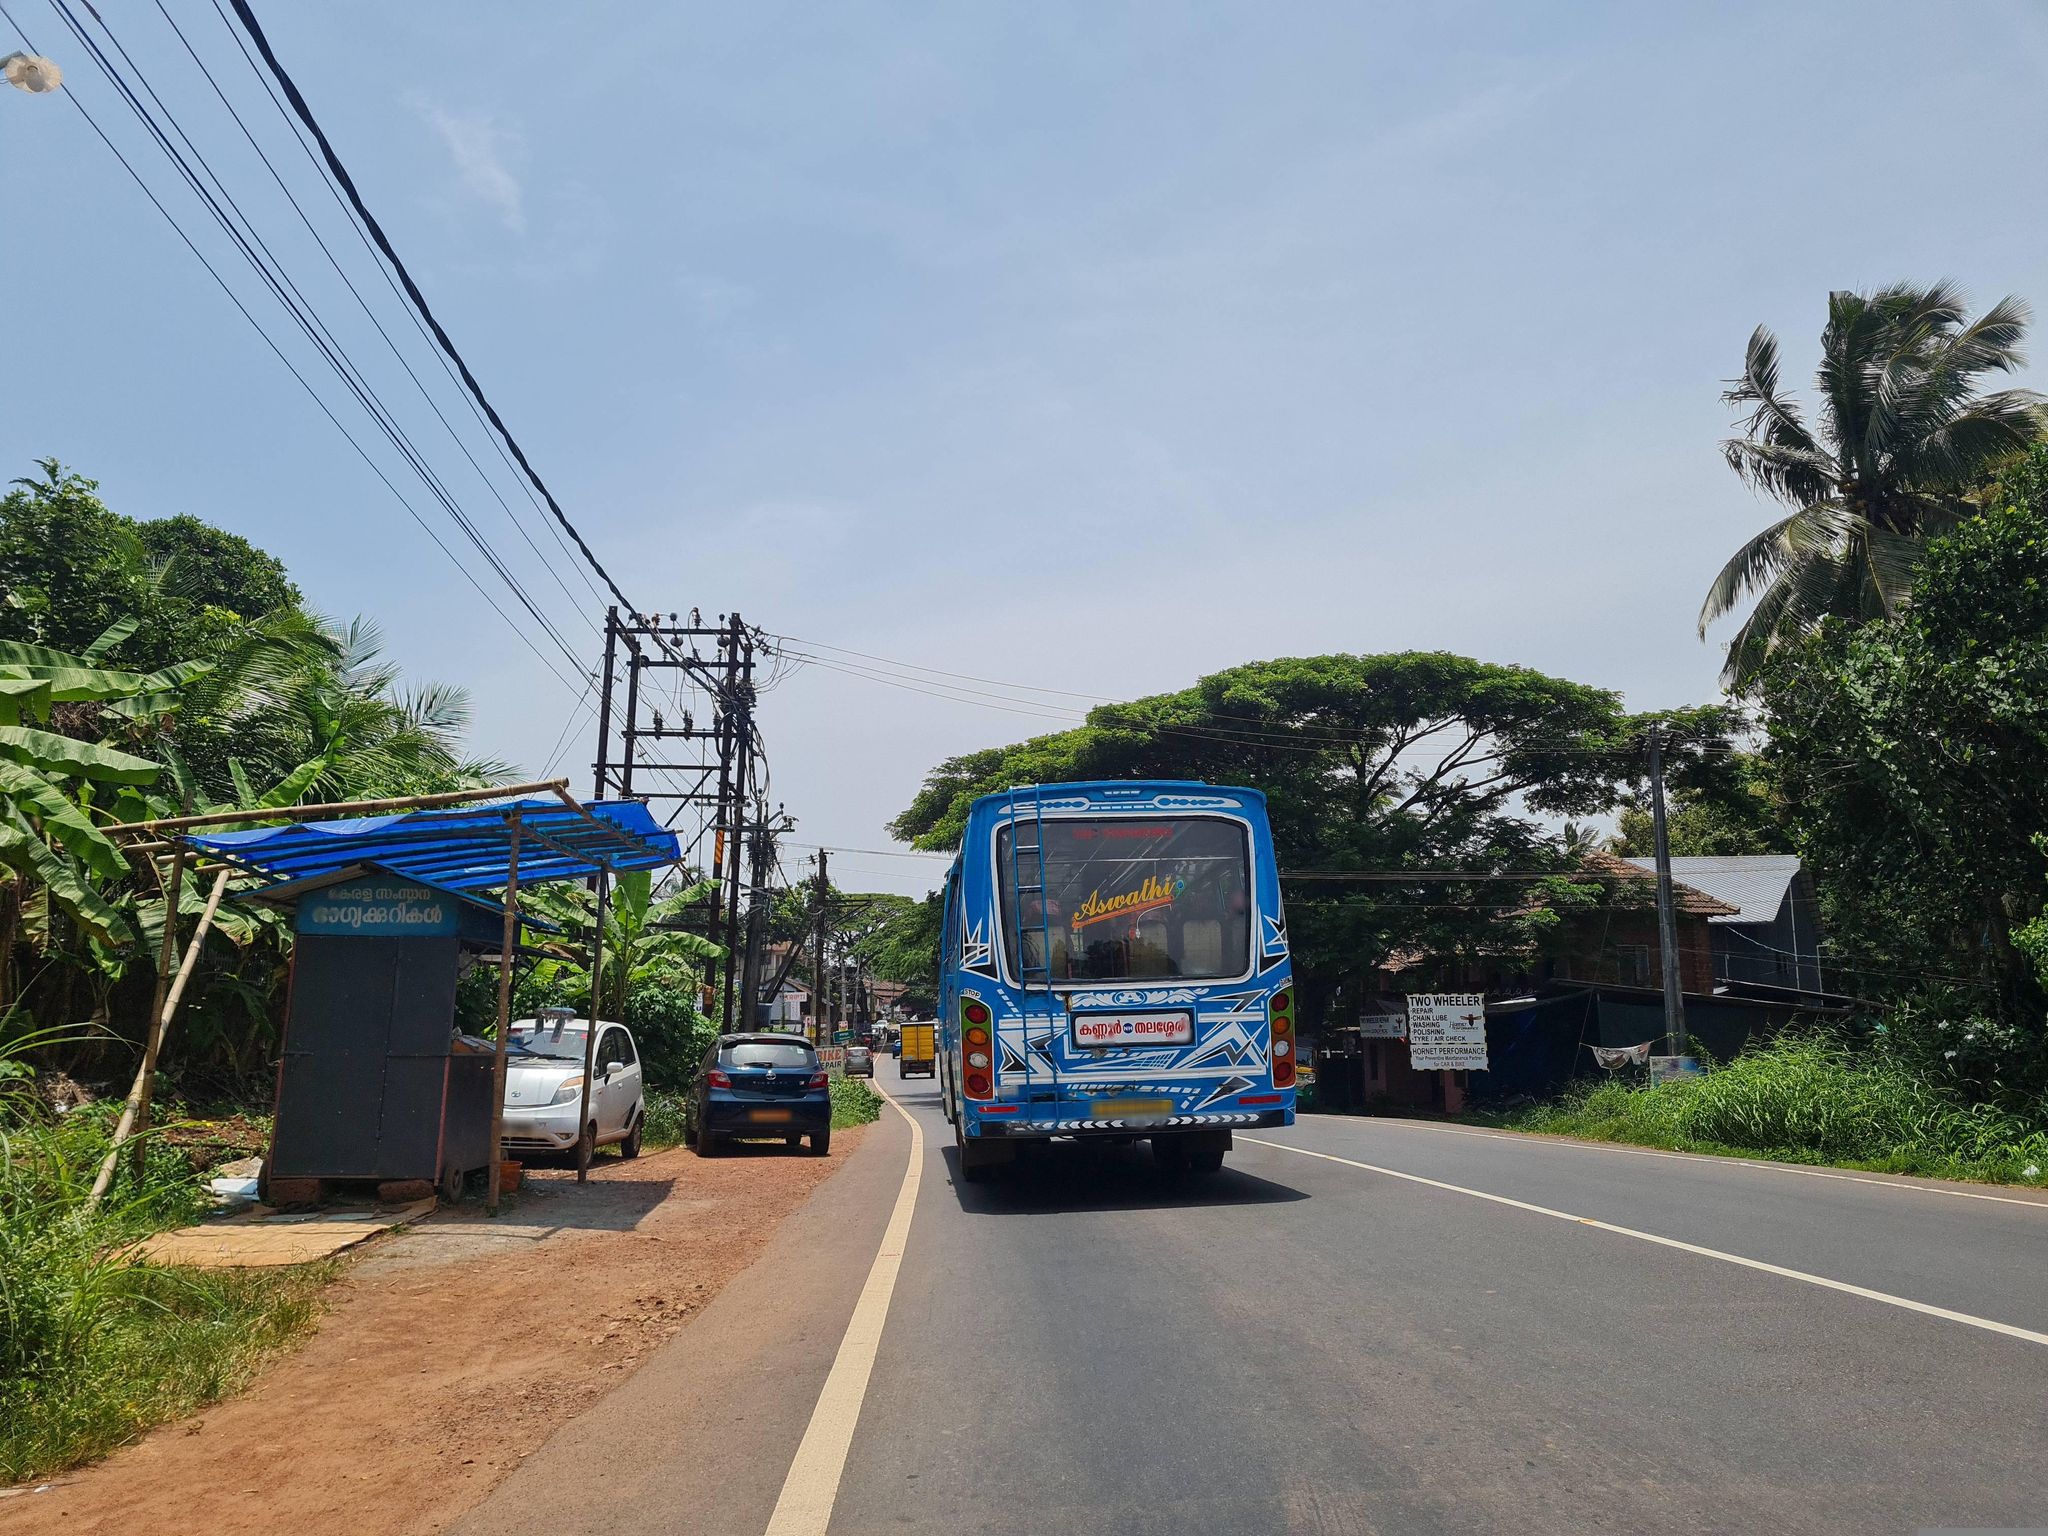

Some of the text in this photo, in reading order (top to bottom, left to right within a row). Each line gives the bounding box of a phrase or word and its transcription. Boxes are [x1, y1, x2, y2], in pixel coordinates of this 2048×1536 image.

[1074, 873, 1175, 920] Aswathi
[965, 989, 980, 997] STOP
[1409, 996, 1480, 1007] TWO WHEELER
[818, 1048, 842, 1060] BIKE
[1412, 1047, 1485, 1055] HORNET PERFORMANCE
